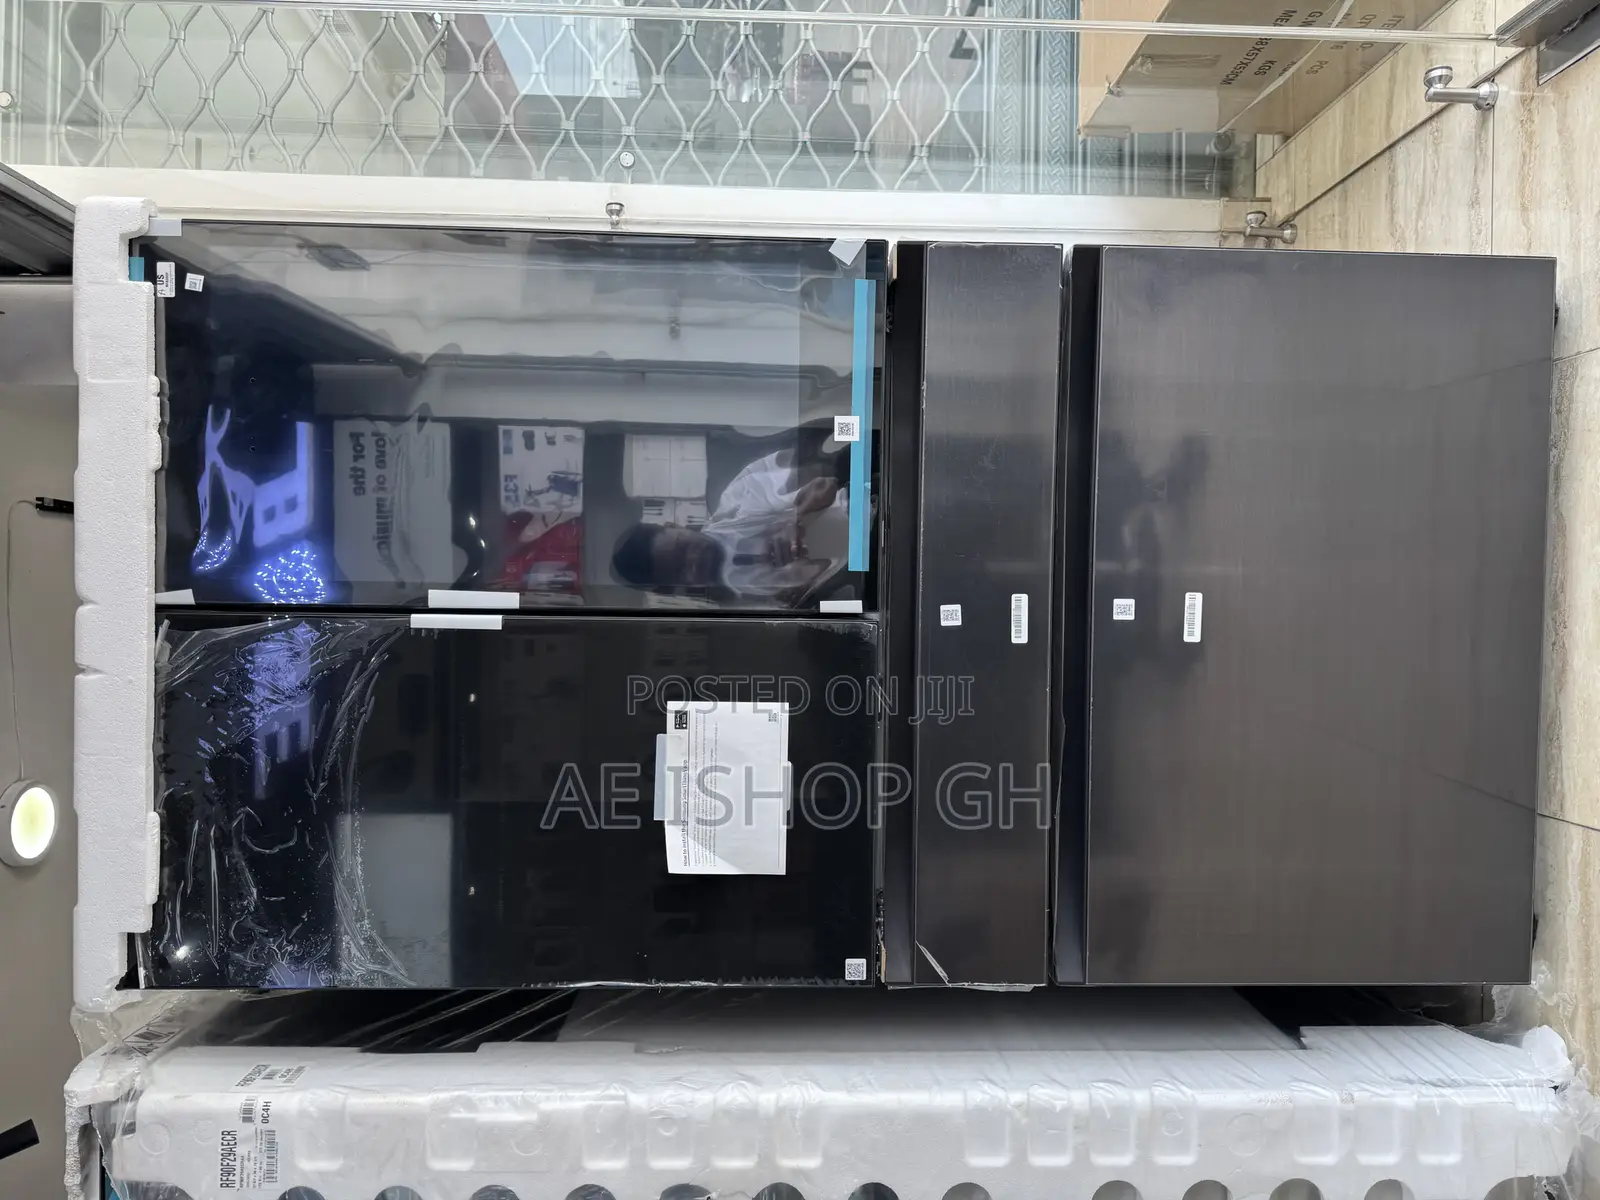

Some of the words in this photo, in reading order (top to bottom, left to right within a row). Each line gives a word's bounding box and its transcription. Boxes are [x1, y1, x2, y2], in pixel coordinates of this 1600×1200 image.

[1253, 60, 1278, 77] KGS
[1306, 60, 1329, 76] PCS
[220, 1130, 238, 1189] RF90F29AECR
